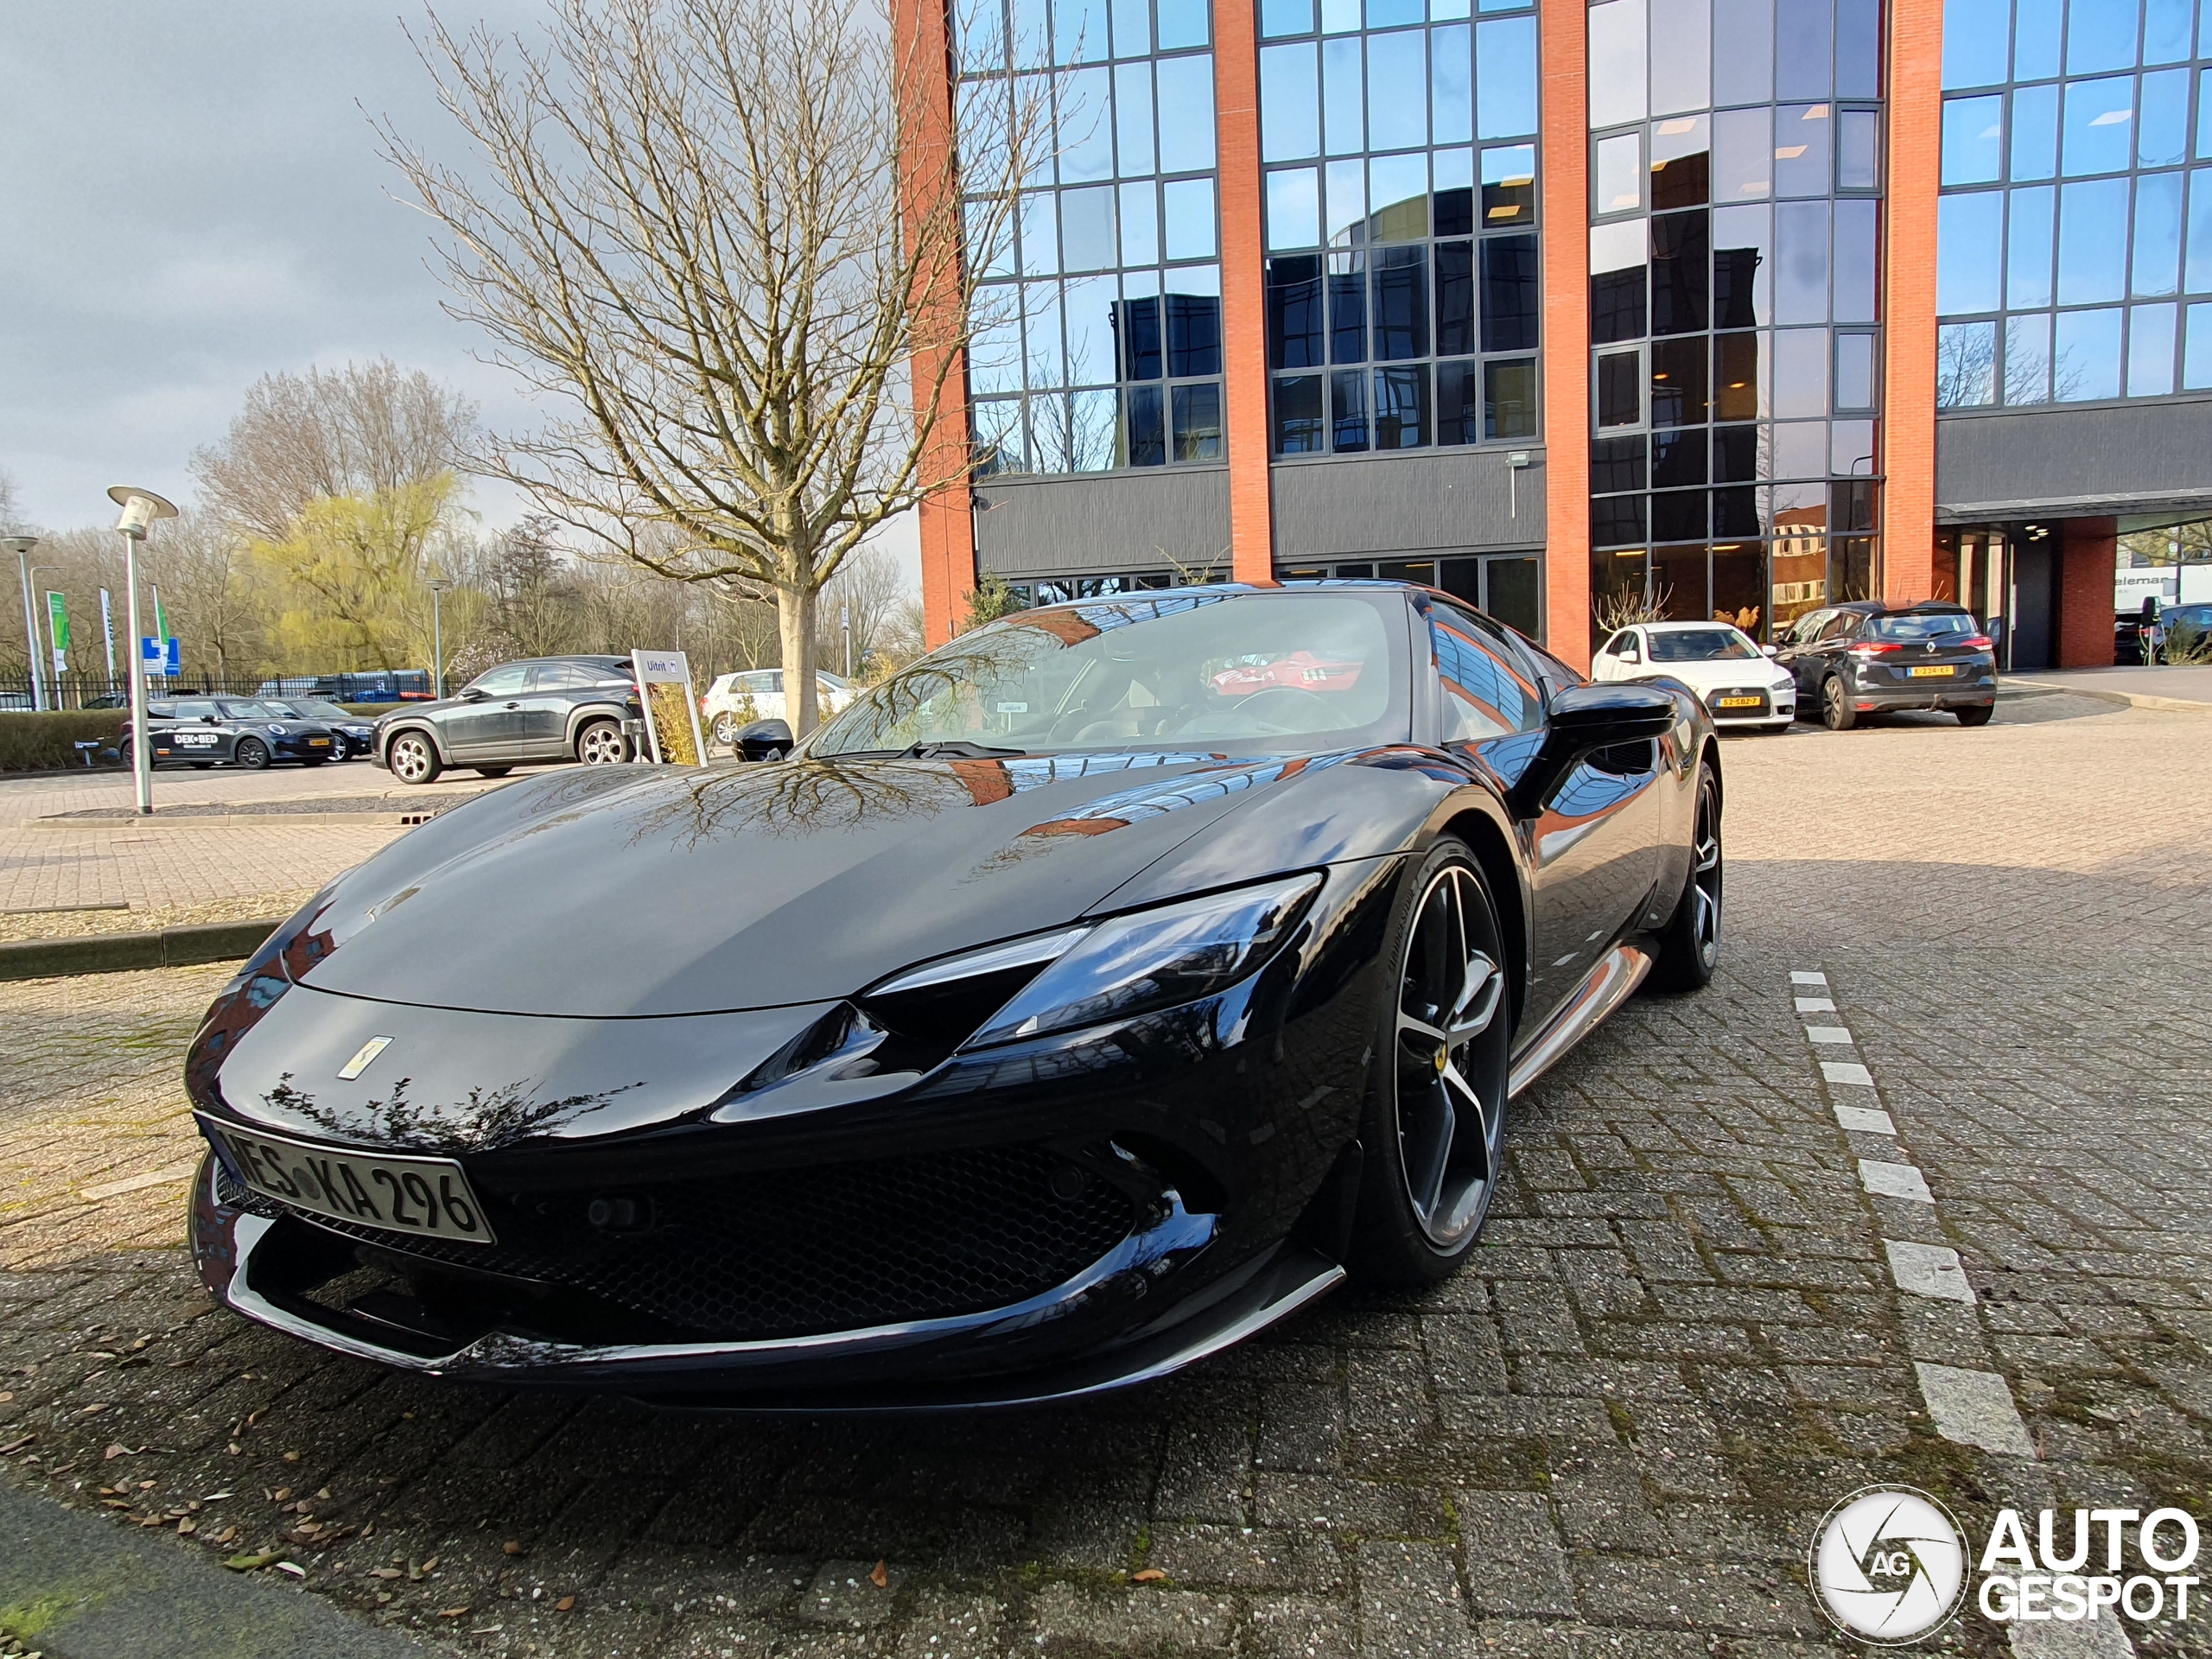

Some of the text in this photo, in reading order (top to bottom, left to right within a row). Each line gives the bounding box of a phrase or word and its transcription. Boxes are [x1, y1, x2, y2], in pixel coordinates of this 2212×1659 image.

[646, 659, 667, 672] Uitrit
[305, 1156, 382, 1220] KA
[372, 1166, 477, 1233] 296
